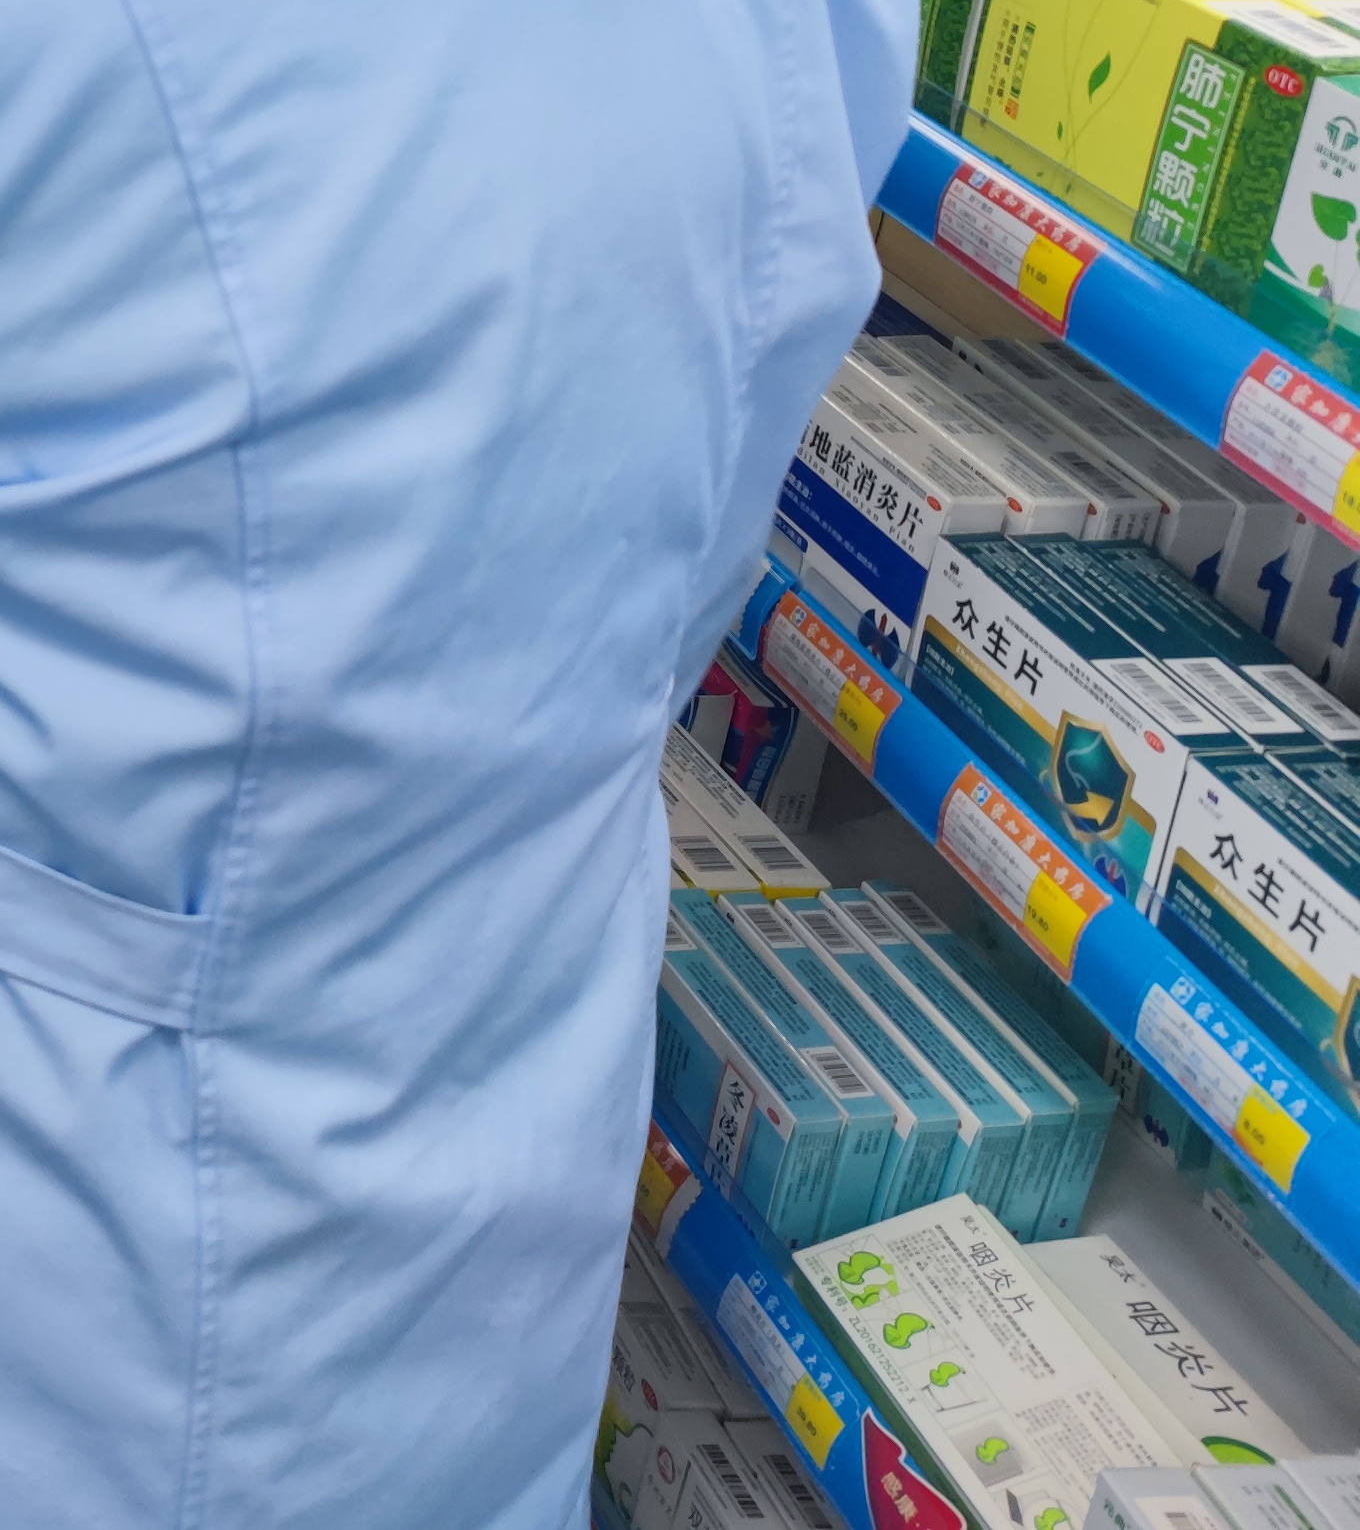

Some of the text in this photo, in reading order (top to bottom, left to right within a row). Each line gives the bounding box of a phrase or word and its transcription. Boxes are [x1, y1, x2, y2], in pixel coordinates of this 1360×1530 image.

[1268, 69, 1300, 94] OTC
[1146, 52, 1226, 249] 肺宁颗粒
[801, 421, 923, 539] 地蓝消炎片
[952, 598, 1044, 696] 众生片
[1209, 833, 1326, 953] 众生片
[968, 1241, 1035, 1314] 咽炎片
[1126, 1301, 1249, 1417] 咽炎片
